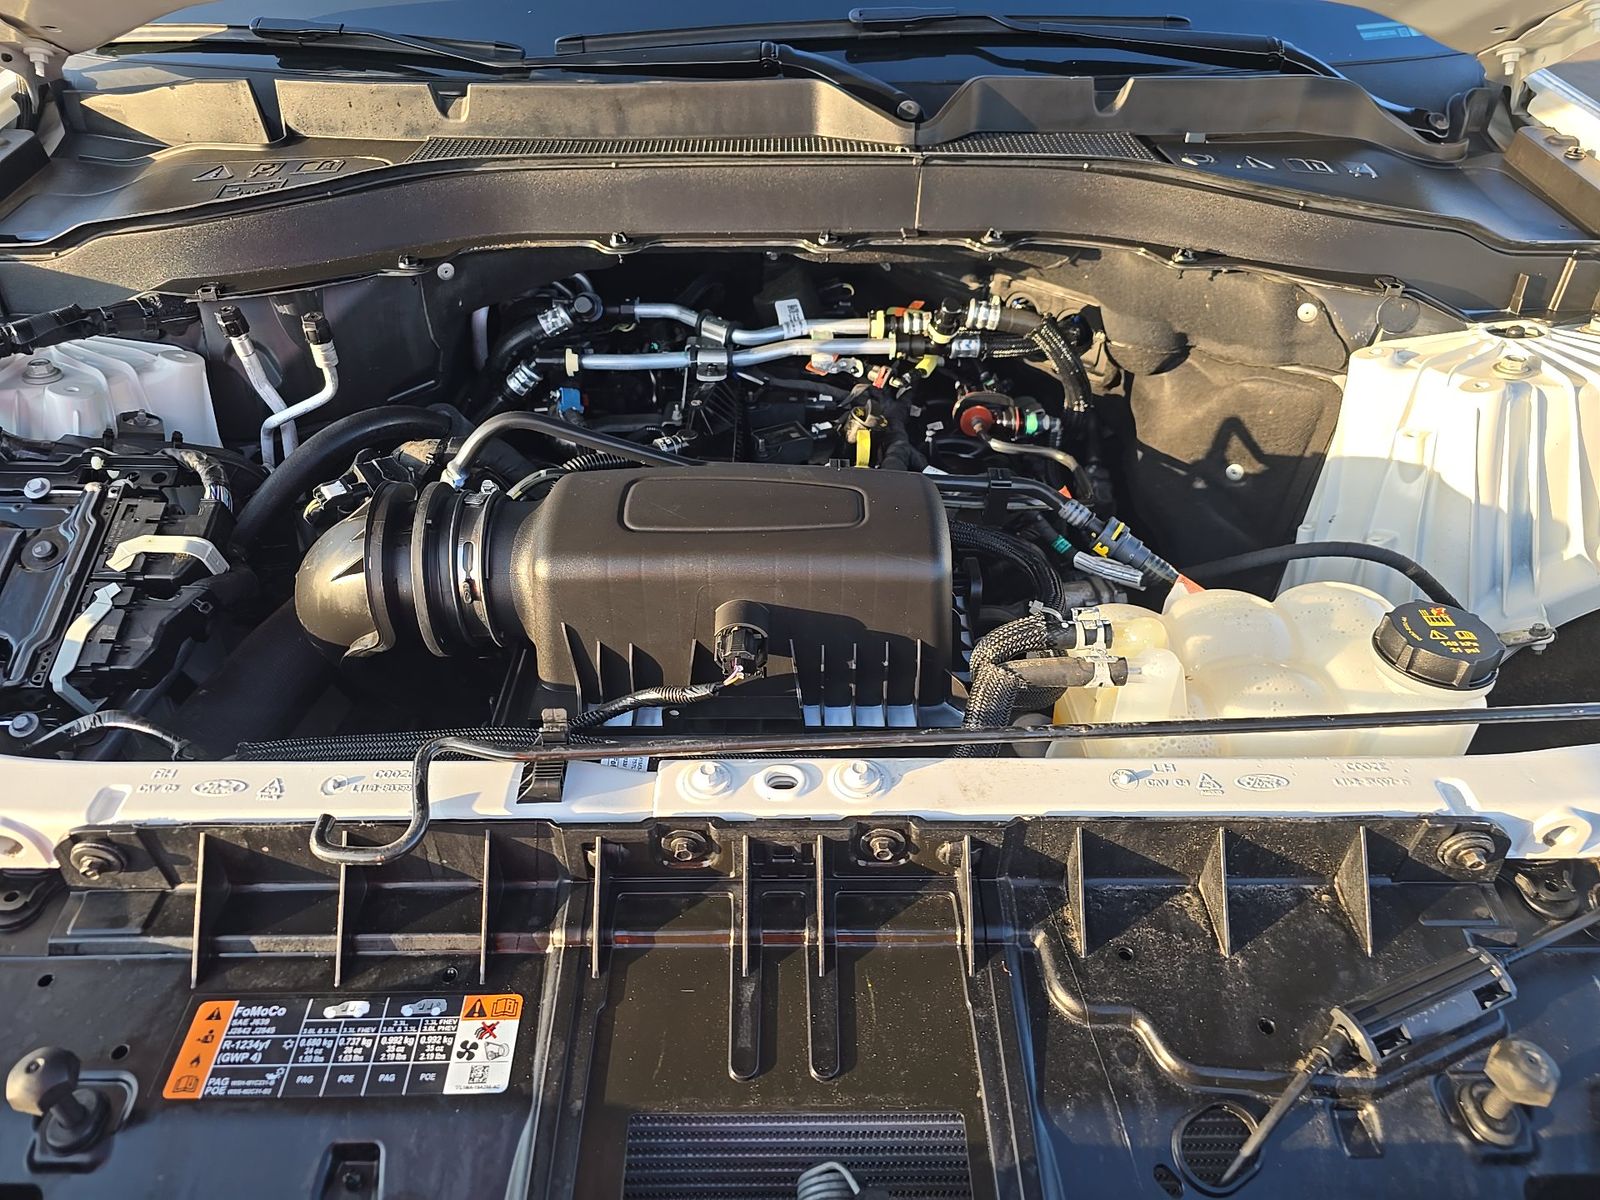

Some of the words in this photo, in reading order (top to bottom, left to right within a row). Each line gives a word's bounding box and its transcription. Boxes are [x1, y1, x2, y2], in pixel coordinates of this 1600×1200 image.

[1152, 763, 1178, 774] LH
[235, 1006, 287, 1017] FoMoCo
[231, 1018, 250, 1026] SAE
[222, 1040, 272, 1051] R-1234yf
[322, 1037, 334, 1049] kg
[338, 1037, 361, 1047] 0.737
[361, 1036, 374, 1048] kg
[403, 1035, 416, 1047] kg
[419, 1035, 442, 1045] 0.992
[442, 1034, 454, 1046] kg
[217, 1052, 250, 1064] (GWP
[250, 1051, 263, 1064] 4)
[206, 1077, 230, 1087] PAG
[296, 1075, 314, 1084] PAG
[337, 1074, 355, 1083] POE
[378, 1073, 396, 1082] PAG
[419, 1072, 437, 1081] POE
[204, 1086, 227, 1096] POE
